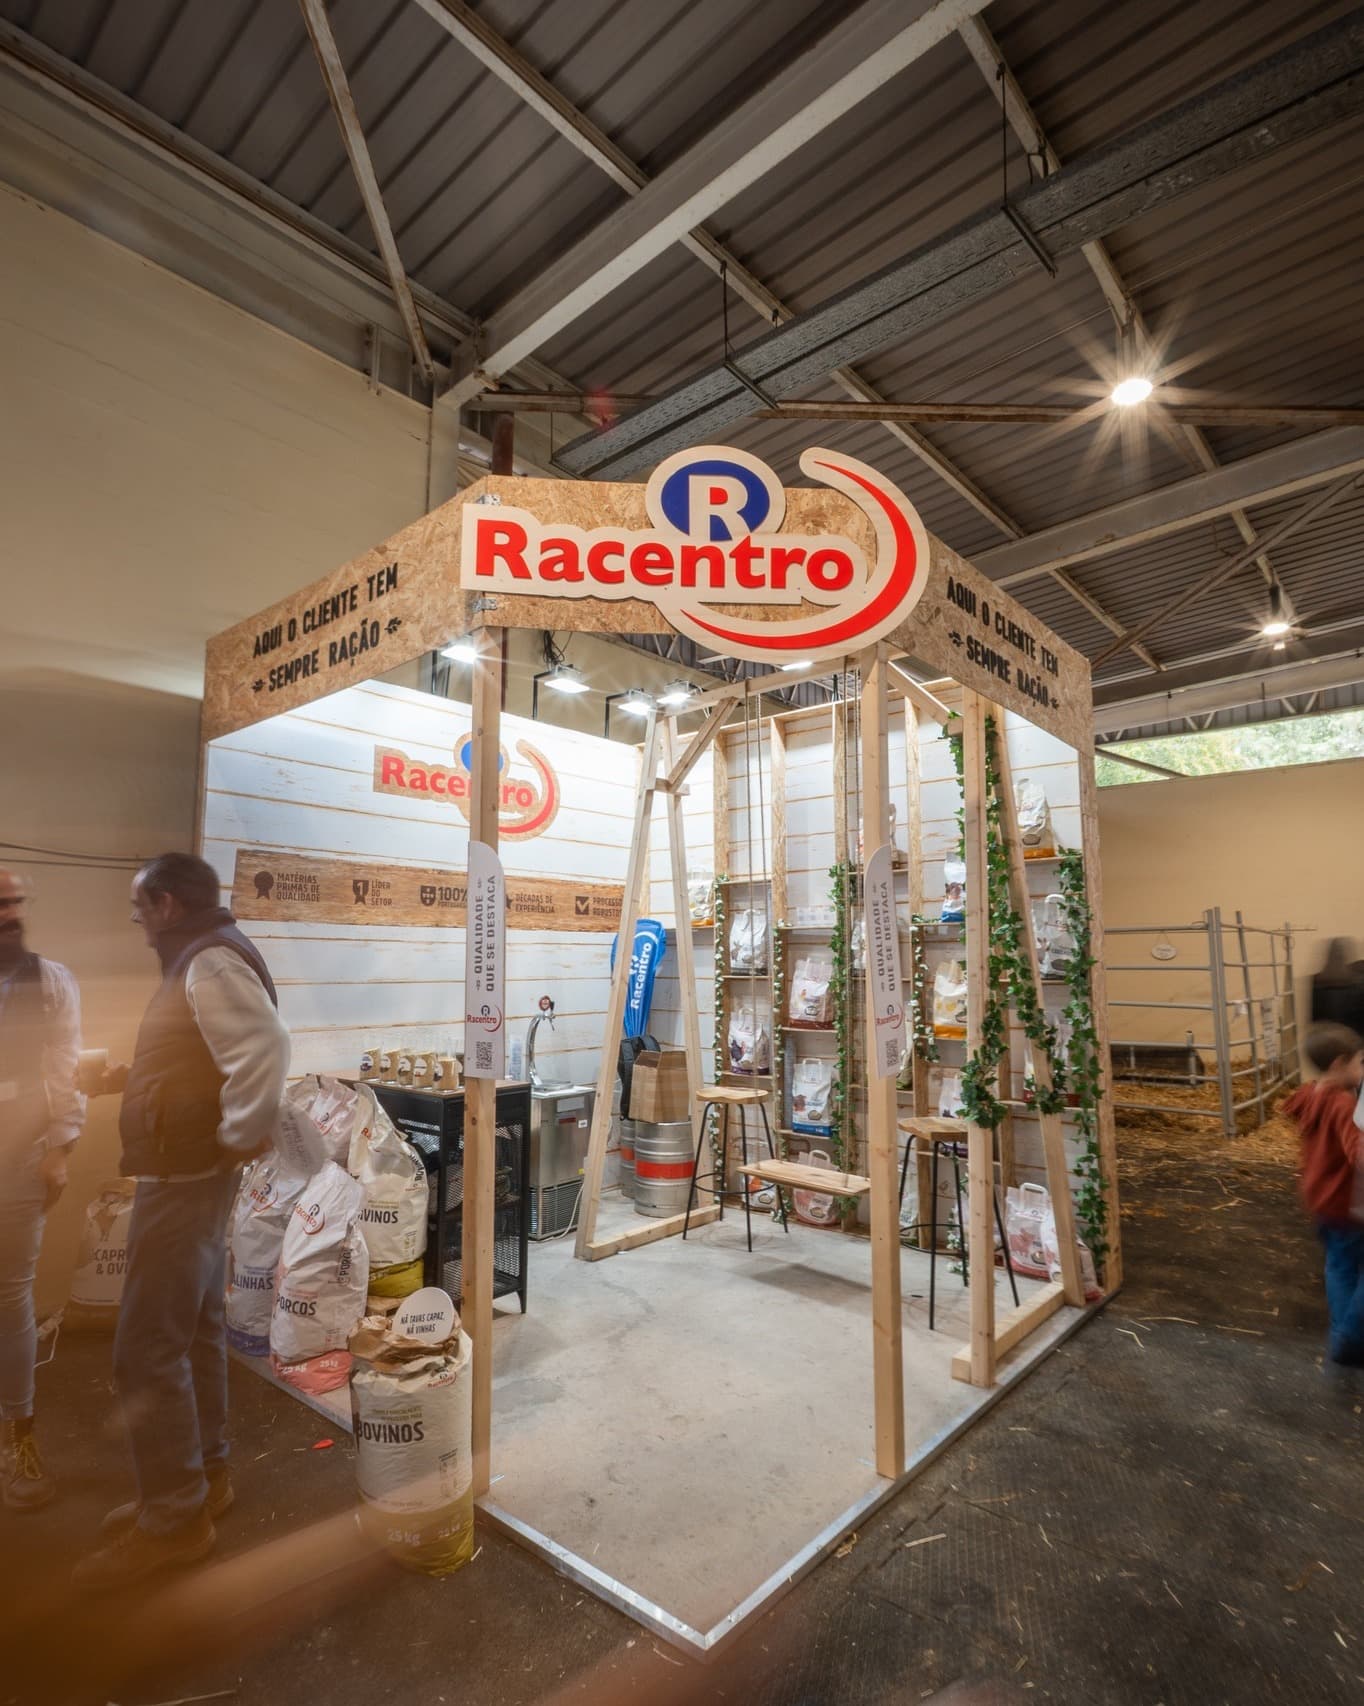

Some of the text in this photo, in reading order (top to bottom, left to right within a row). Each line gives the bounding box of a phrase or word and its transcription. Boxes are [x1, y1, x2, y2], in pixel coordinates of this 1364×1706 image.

[688, 474, 752, 541] R
[475, 518, 854, 592] Racentro
[253, 562, 398, 659] AQUI O CLIENTE TEM
[947, 576, 1059, 678] AQUI O CLIENTE TEM
[269, 618, 380, 692] SEMPRE RAÇÃO
[966, 635, 1049, 707] SEMPRE RAÇÃO
[381, 755, 534, 808] Racero
[277, 872, 318, 884] MATÉRIAS
[371, 879, 391, 889] LÍDER
[277, 883, 321, 894] PRIMAS DE
[371, 889, 381, 898] DO
[438, 886, 468, 902] 100%
[276, 892, 321, 903] QUALIDADE
[371, 898, 393, 906] SETOR
[515, 893, 543, 903] DÉCADAS
[515, 902, 555, 914] EXPERIÊNCIA
[474, 894, 484, 975] QUALIDADE
[486, 874, 496, 992] QUE SE DESTACA
[872, 900, 885, 977] QUALIDADE
[880, 881, 896, 992] QUE SE DESTACA
[631, 942, 652, 1010] Racentro
[467, 1013, 497, 1025] Racentro
[95, 1248, 126, 1261] CAPR
[107, 1262, 129, 1274] OVI
[415, 1323, 436, 1334] VINHAS
